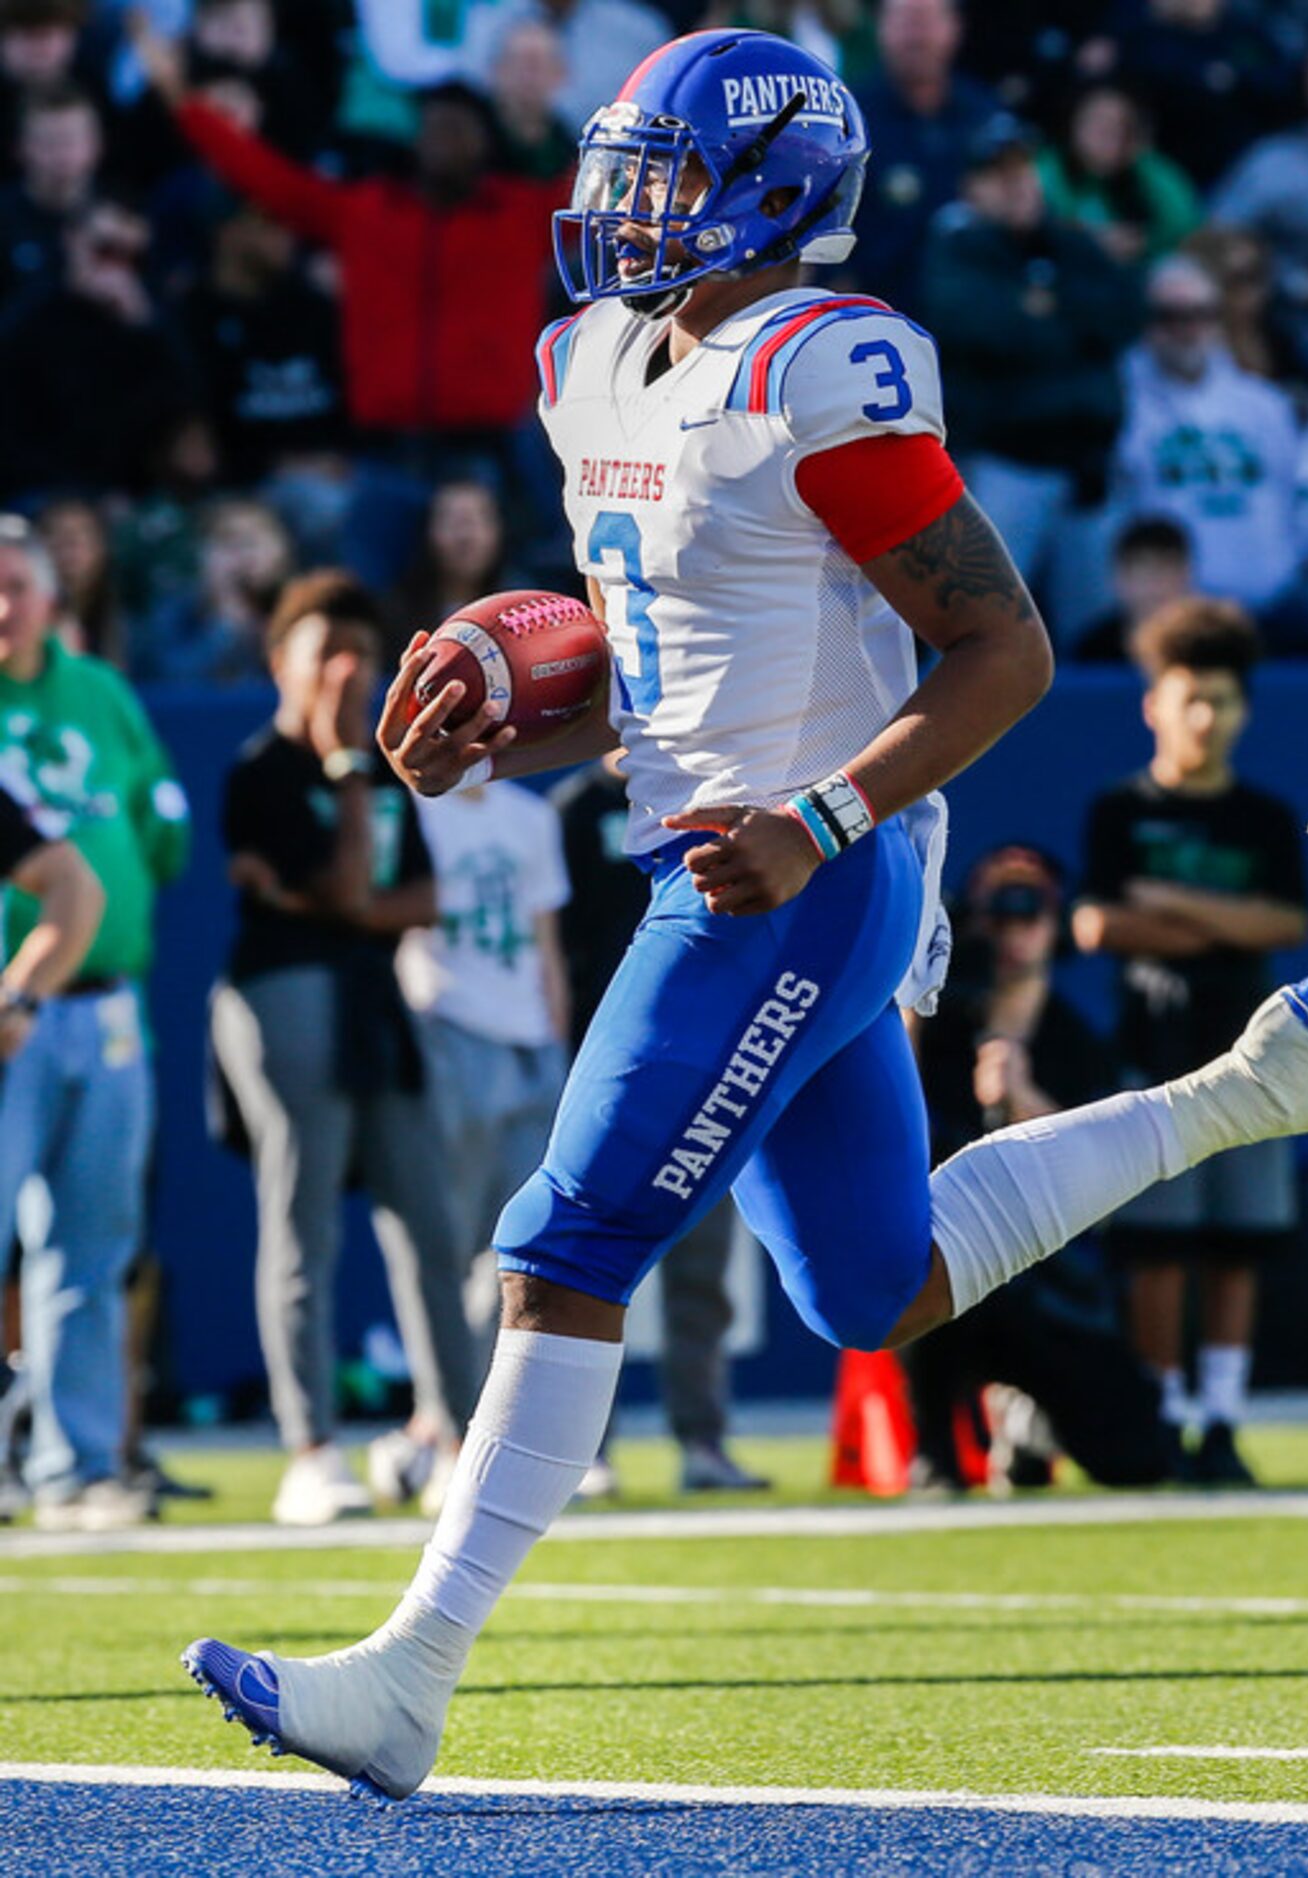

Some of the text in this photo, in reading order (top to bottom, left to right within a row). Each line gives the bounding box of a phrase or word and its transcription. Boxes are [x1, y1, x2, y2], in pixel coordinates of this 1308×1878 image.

[722, 74, 845, 116] PANTHERS
[849, 339, 913, 422] 3
[578, 457, 666, 502] PANTHERS
[588, 510, 663, 716] 3
[652, 970, 820, 1200] PANTHERS
